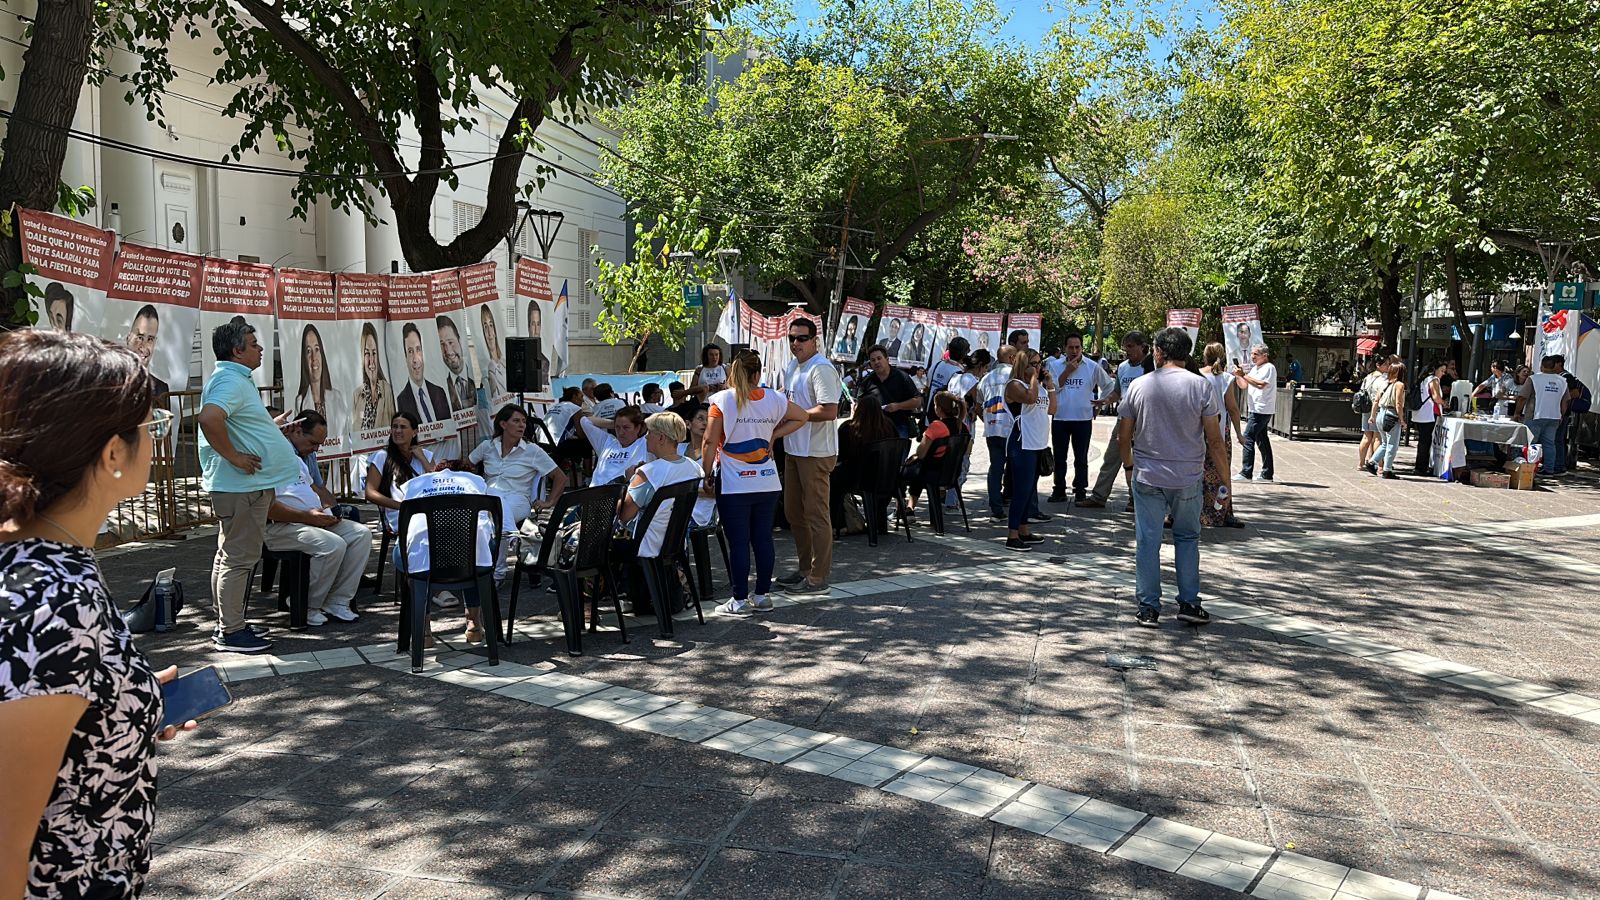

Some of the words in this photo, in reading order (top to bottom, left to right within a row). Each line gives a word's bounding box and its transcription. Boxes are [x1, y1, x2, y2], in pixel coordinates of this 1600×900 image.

[23, 220, 40, 229] usted
[48, 228, 69, 237] conoce
[90, 237, 107, 246] vecina
[48, 237, 63, 247] QUE
[64, 241, 75, 249] NO
[76, 243, 92, 255] VOTE
[93, 248, 100, 256] EL
[27, 243, 50, 256] CORTE
[51, 250, 82, 264] SALARIAL
[83, 258, 100, 268] PARA
[126, 252, 139, 260] usted
[179, 260, 197, 268] vecino
[39, 257, 48, 268] LA
[50, 261, 72, 273] FIESTA
[73, 267, 82, 275] DE
[83, 270, 99, 278] OSEP
[123, 261, 143, 271] PÍDALE
[144, 264, 155, 273] QUE
[156, 266, 165, 274] NO
[166, 268, 180, 276] VOTE
[118, 272, 145, 282] RECORTE
[145, 275, 171, 284] SALARIAL
[172, 278, 191, 288] PARA
[207, 274, 224, 283] PÍDALE
[225, 277, 236, 285] QUE
[244, 279, 258, 287] VOTE
[114, 282, 135, 291] PAGAR
[143, 286, 162, 294] FIESTA
[162, 287, 170, 295] DE
[171, 289, 190, 298] OSEP
[206, 286, 228, 294] RECORTE
[228, 288, 252, 296] SALARIAL
[1065, 378, 1083, 386] SUTE
[1122, 377, 1135, 385] SUT
[322, 437, 341, 446] ARCÍA
[361, 432, 378, 440] FLAVIA
[607, 451, 629, 459] SUTE
